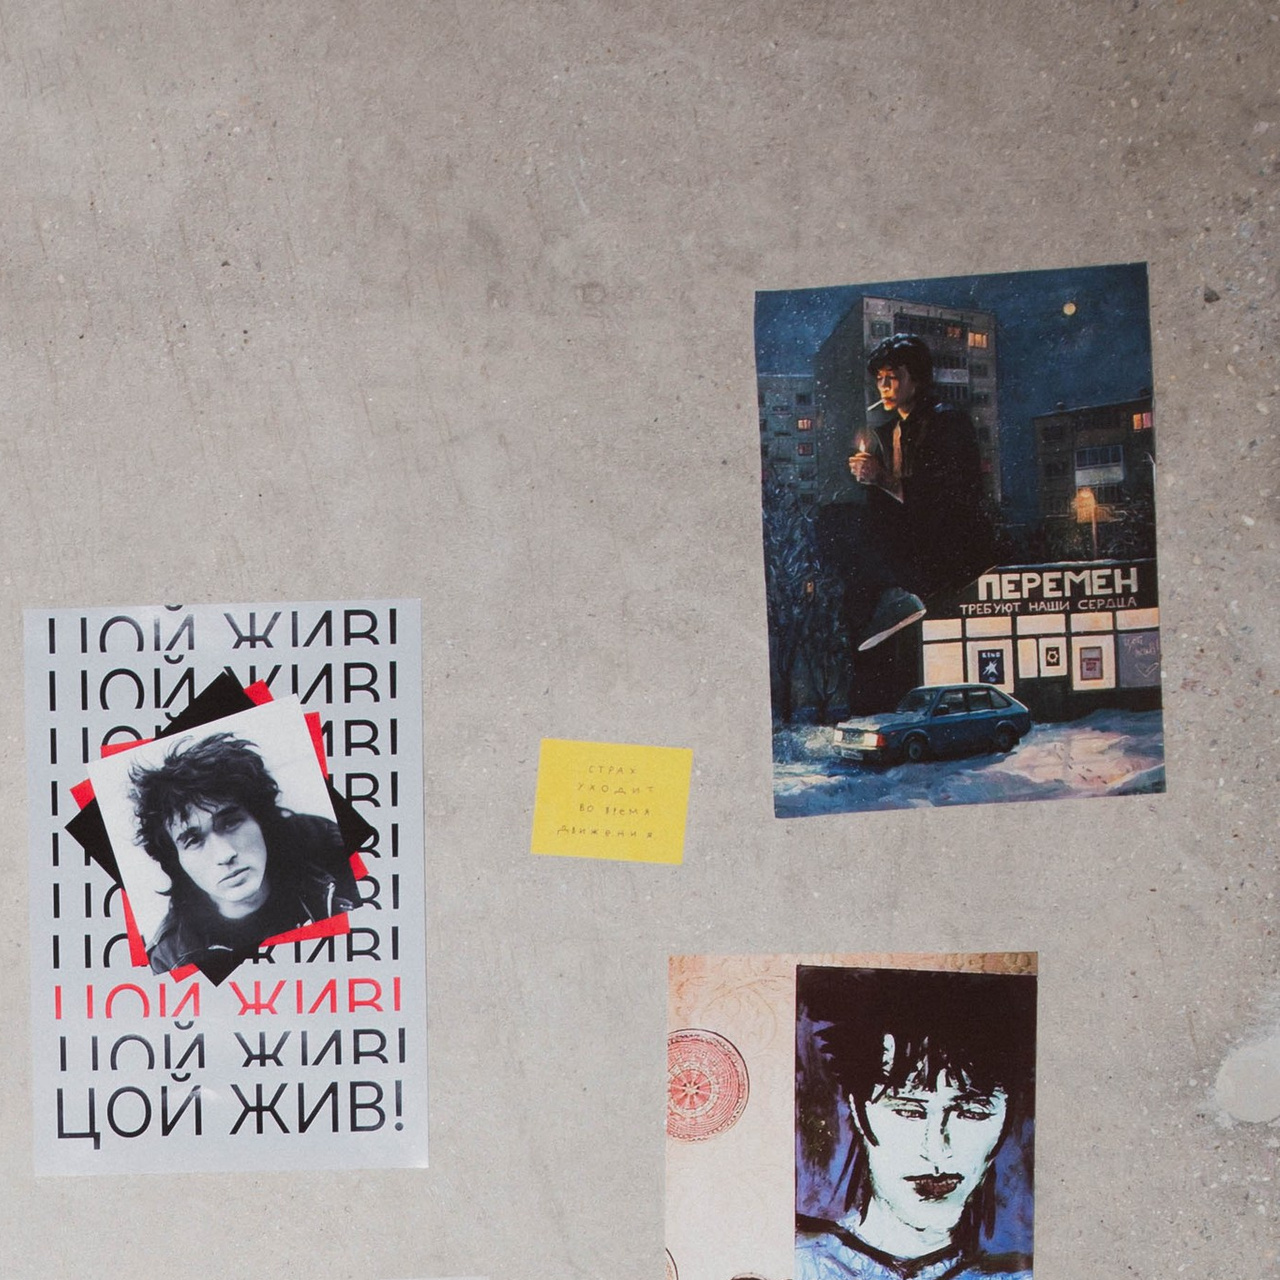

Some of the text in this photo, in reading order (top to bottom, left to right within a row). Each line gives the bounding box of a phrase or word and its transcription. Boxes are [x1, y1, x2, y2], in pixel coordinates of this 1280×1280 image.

[978, 567, 1138, 600] ПЕРЕМЕН
[959, 596, 1137, 616] ТРЕБУЮТ НАШИ СЕРДЦА
[588, 765, 637, 775] СТРАХ
[57, 1072, 404, 1150] ЦОЙ ЖИВ!
